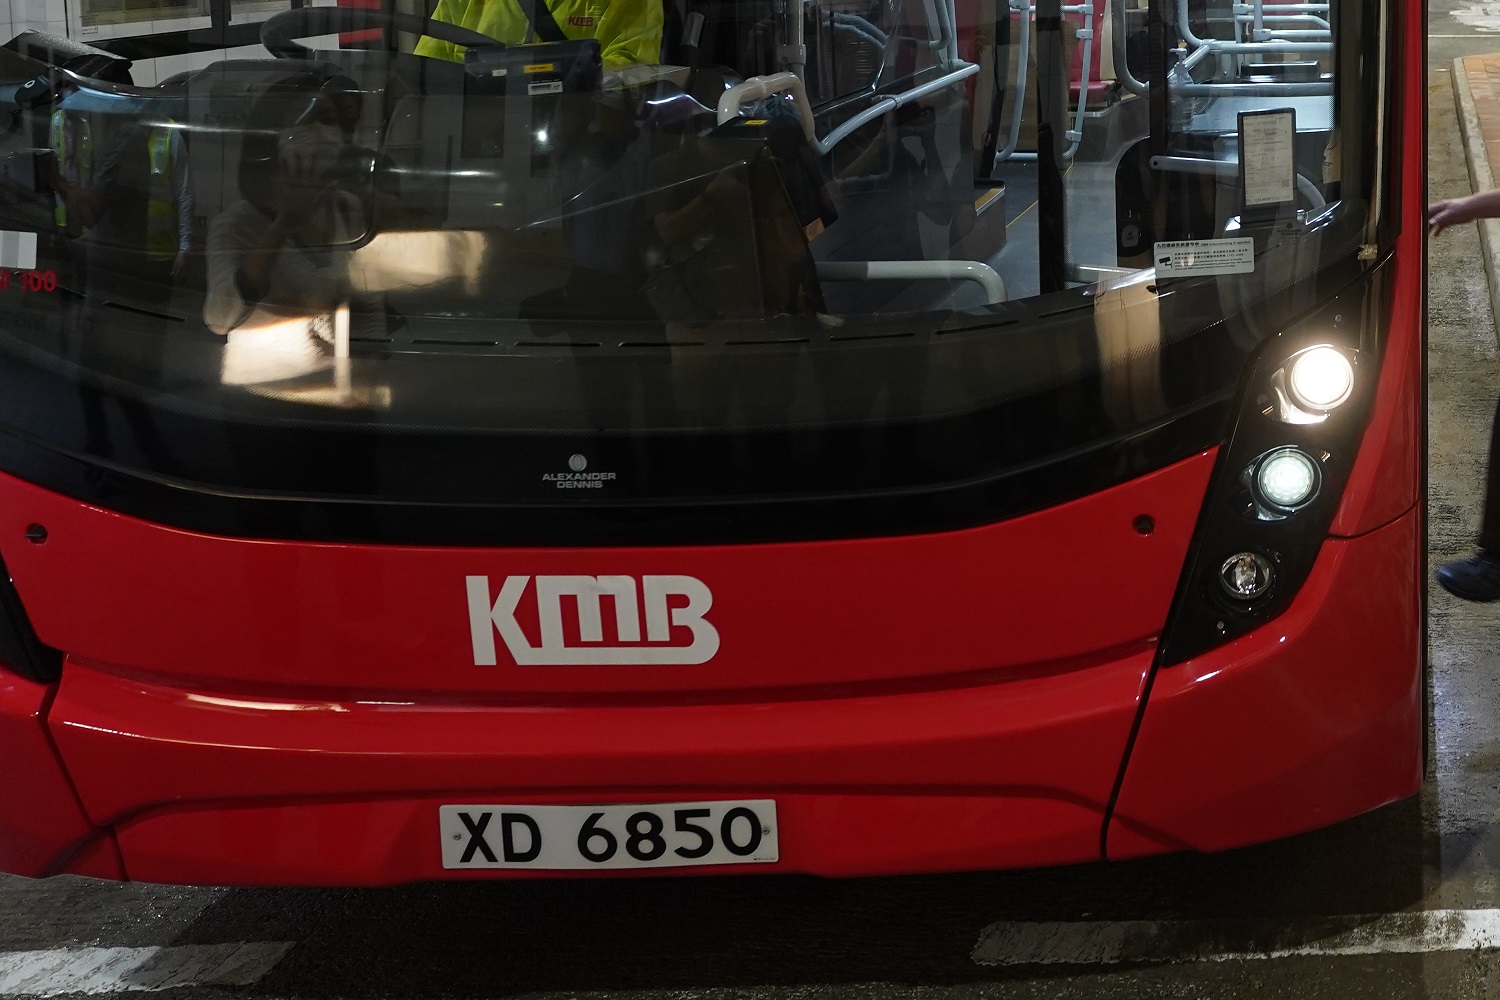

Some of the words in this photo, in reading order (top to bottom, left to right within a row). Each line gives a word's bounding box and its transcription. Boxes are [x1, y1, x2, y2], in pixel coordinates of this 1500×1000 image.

[19, 269, 57, 293] 100
[541, 472, 617, 481] ALEXANDER
[556, 480, 603, 489] DENNIS
[465, 574, 720, 666] KMB
[456, 812, 542, 863] XD
[577, 806, 762, 863] 6850
